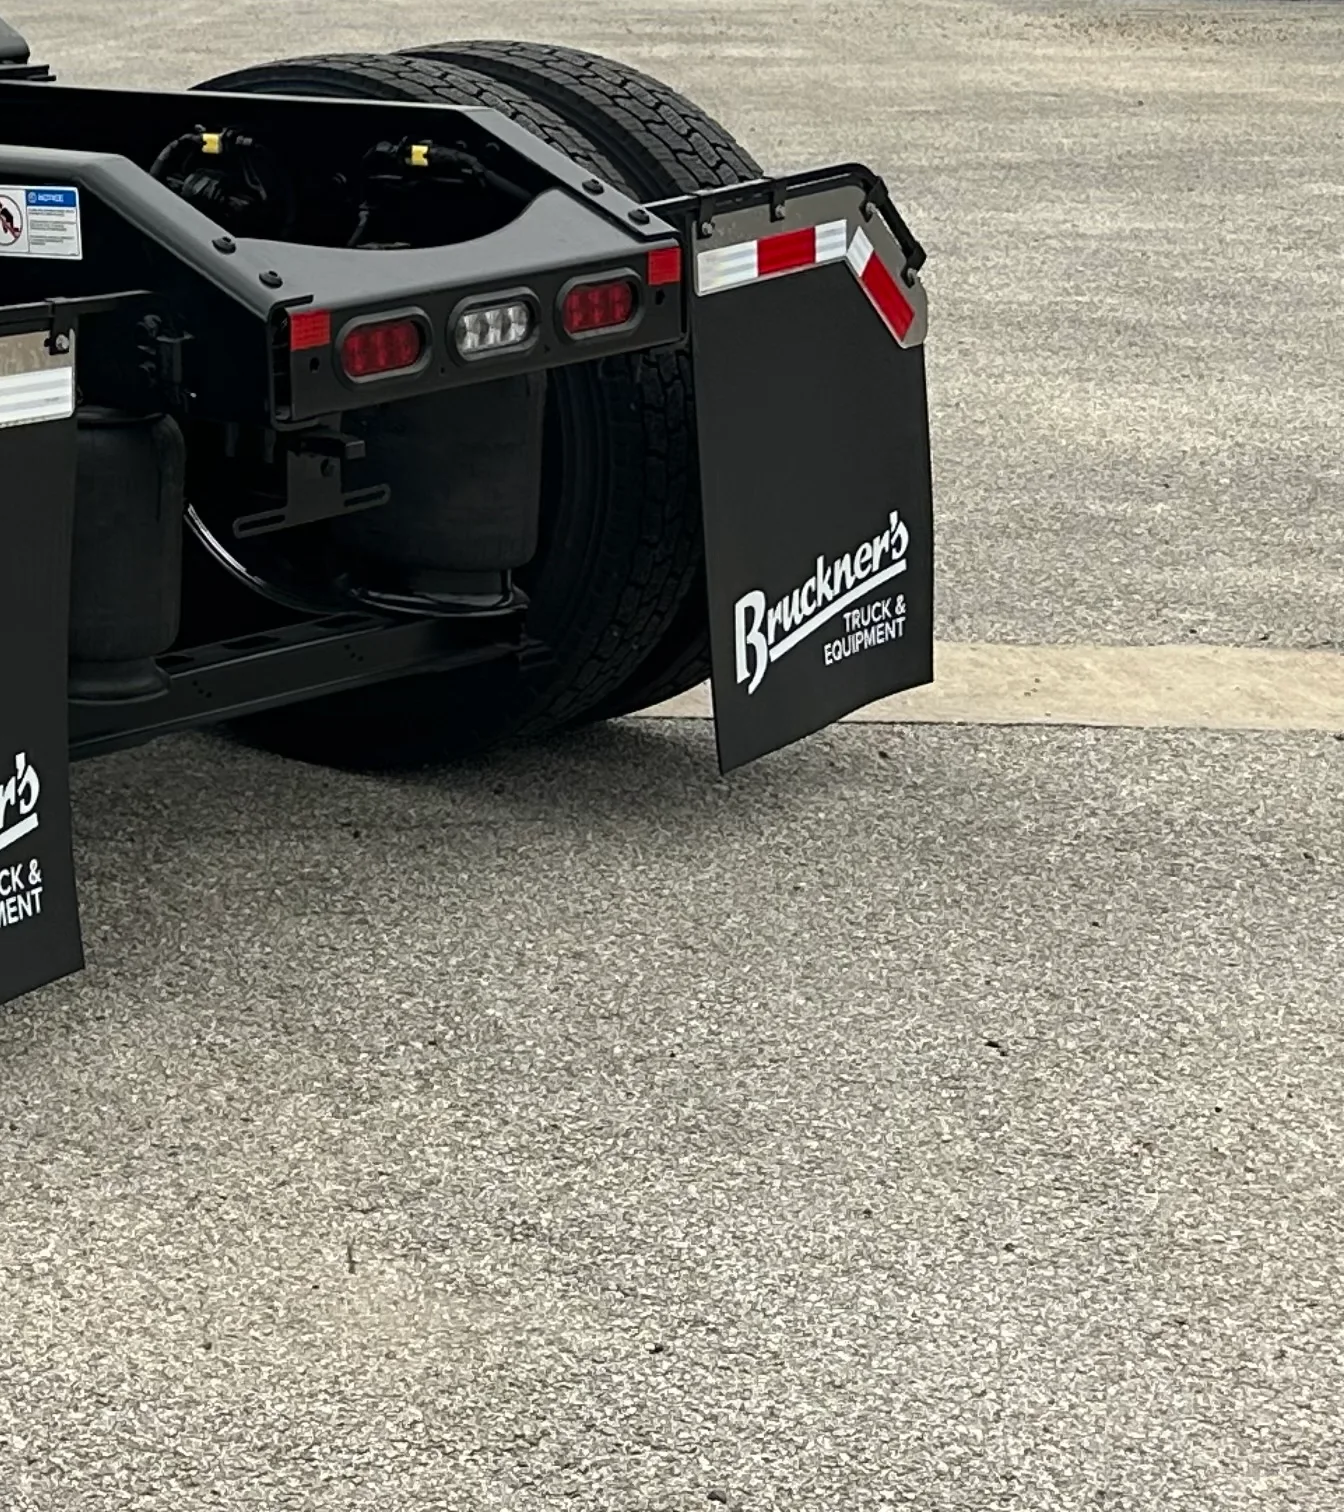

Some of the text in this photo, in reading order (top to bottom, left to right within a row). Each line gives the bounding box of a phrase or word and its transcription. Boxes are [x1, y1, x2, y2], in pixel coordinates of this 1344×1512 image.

[734, 510, 910, 695] Bruckner's
[843, 594, 907, 633] TRUCK &
[823, 616, 907, 666] EQUIPMENT
[27, 858, 43, 885] &
